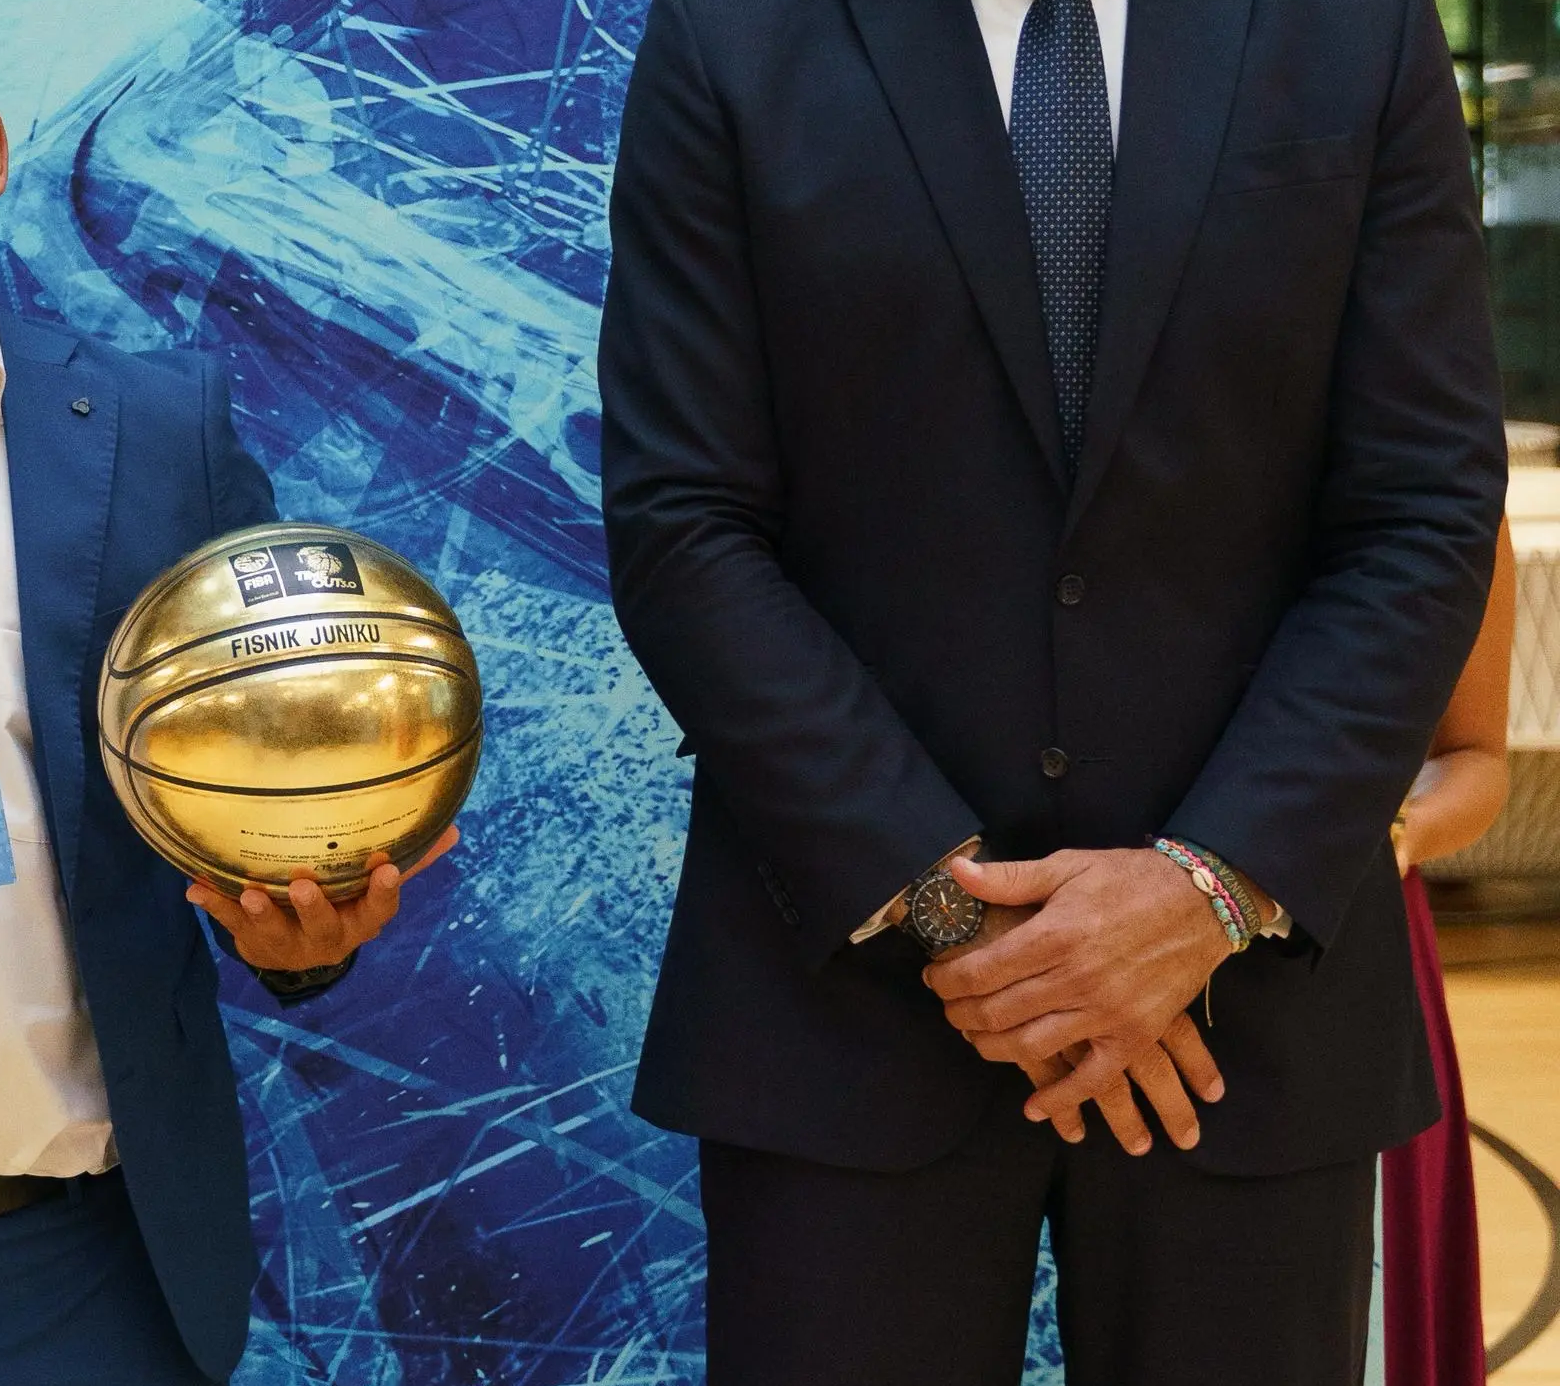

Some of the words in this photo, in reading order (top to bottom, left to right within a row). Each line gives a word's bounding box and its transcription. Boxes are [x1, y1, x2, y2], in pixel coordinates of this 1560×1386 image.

[294, 570, 328, 582] TIME
[231, 629, 301, 658] FISNIK
[310, 623, 381, 646] JUNIKU
